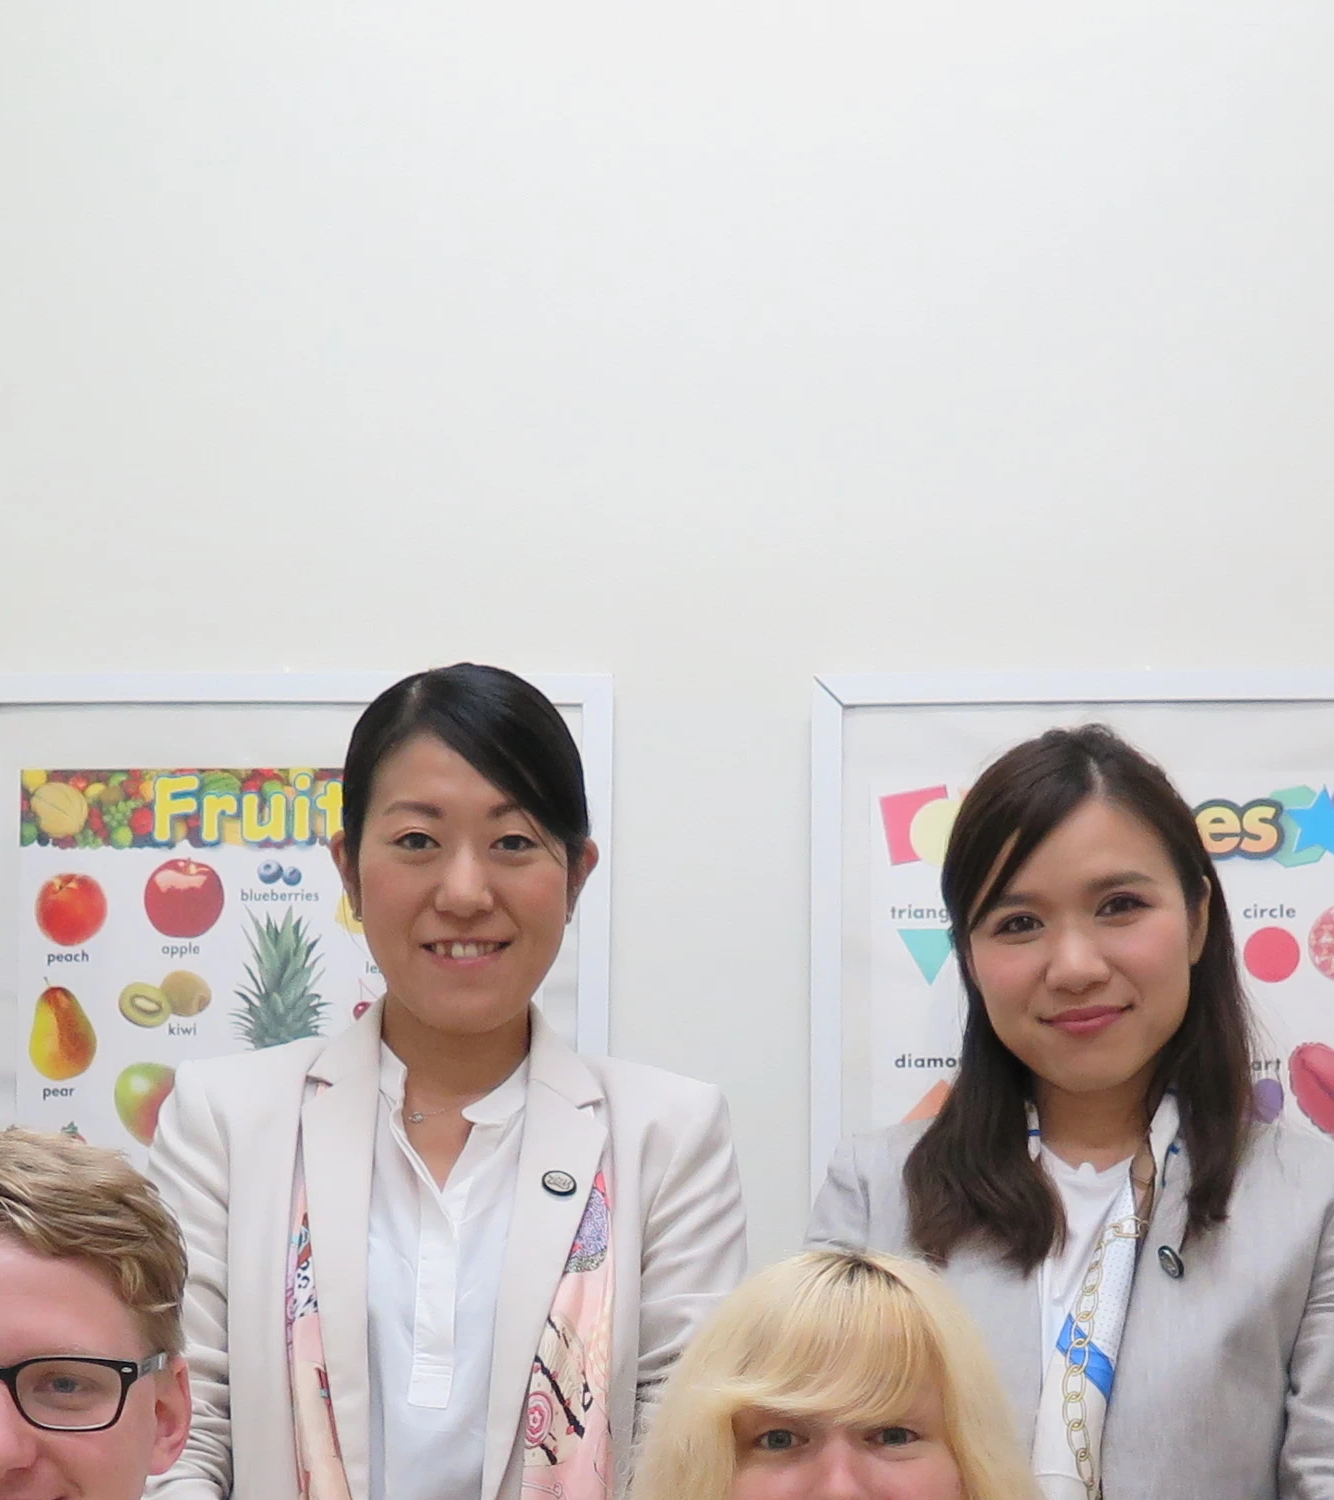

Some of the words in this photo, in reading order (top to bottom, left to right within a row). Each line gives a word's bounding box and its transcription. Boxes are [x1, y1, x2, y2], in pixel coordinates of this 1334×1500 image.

[152, 772, 343, 845] Fruit
[240, 888, 320, 902] blueberries
[1243, 903, 1296, 919] circle
[47, 950, 90, 966] peach
[161, 942, 200, 959] apple
[167, 1022, 197, 1036] kiwi
[42, 1086, 75, 1101] pear
